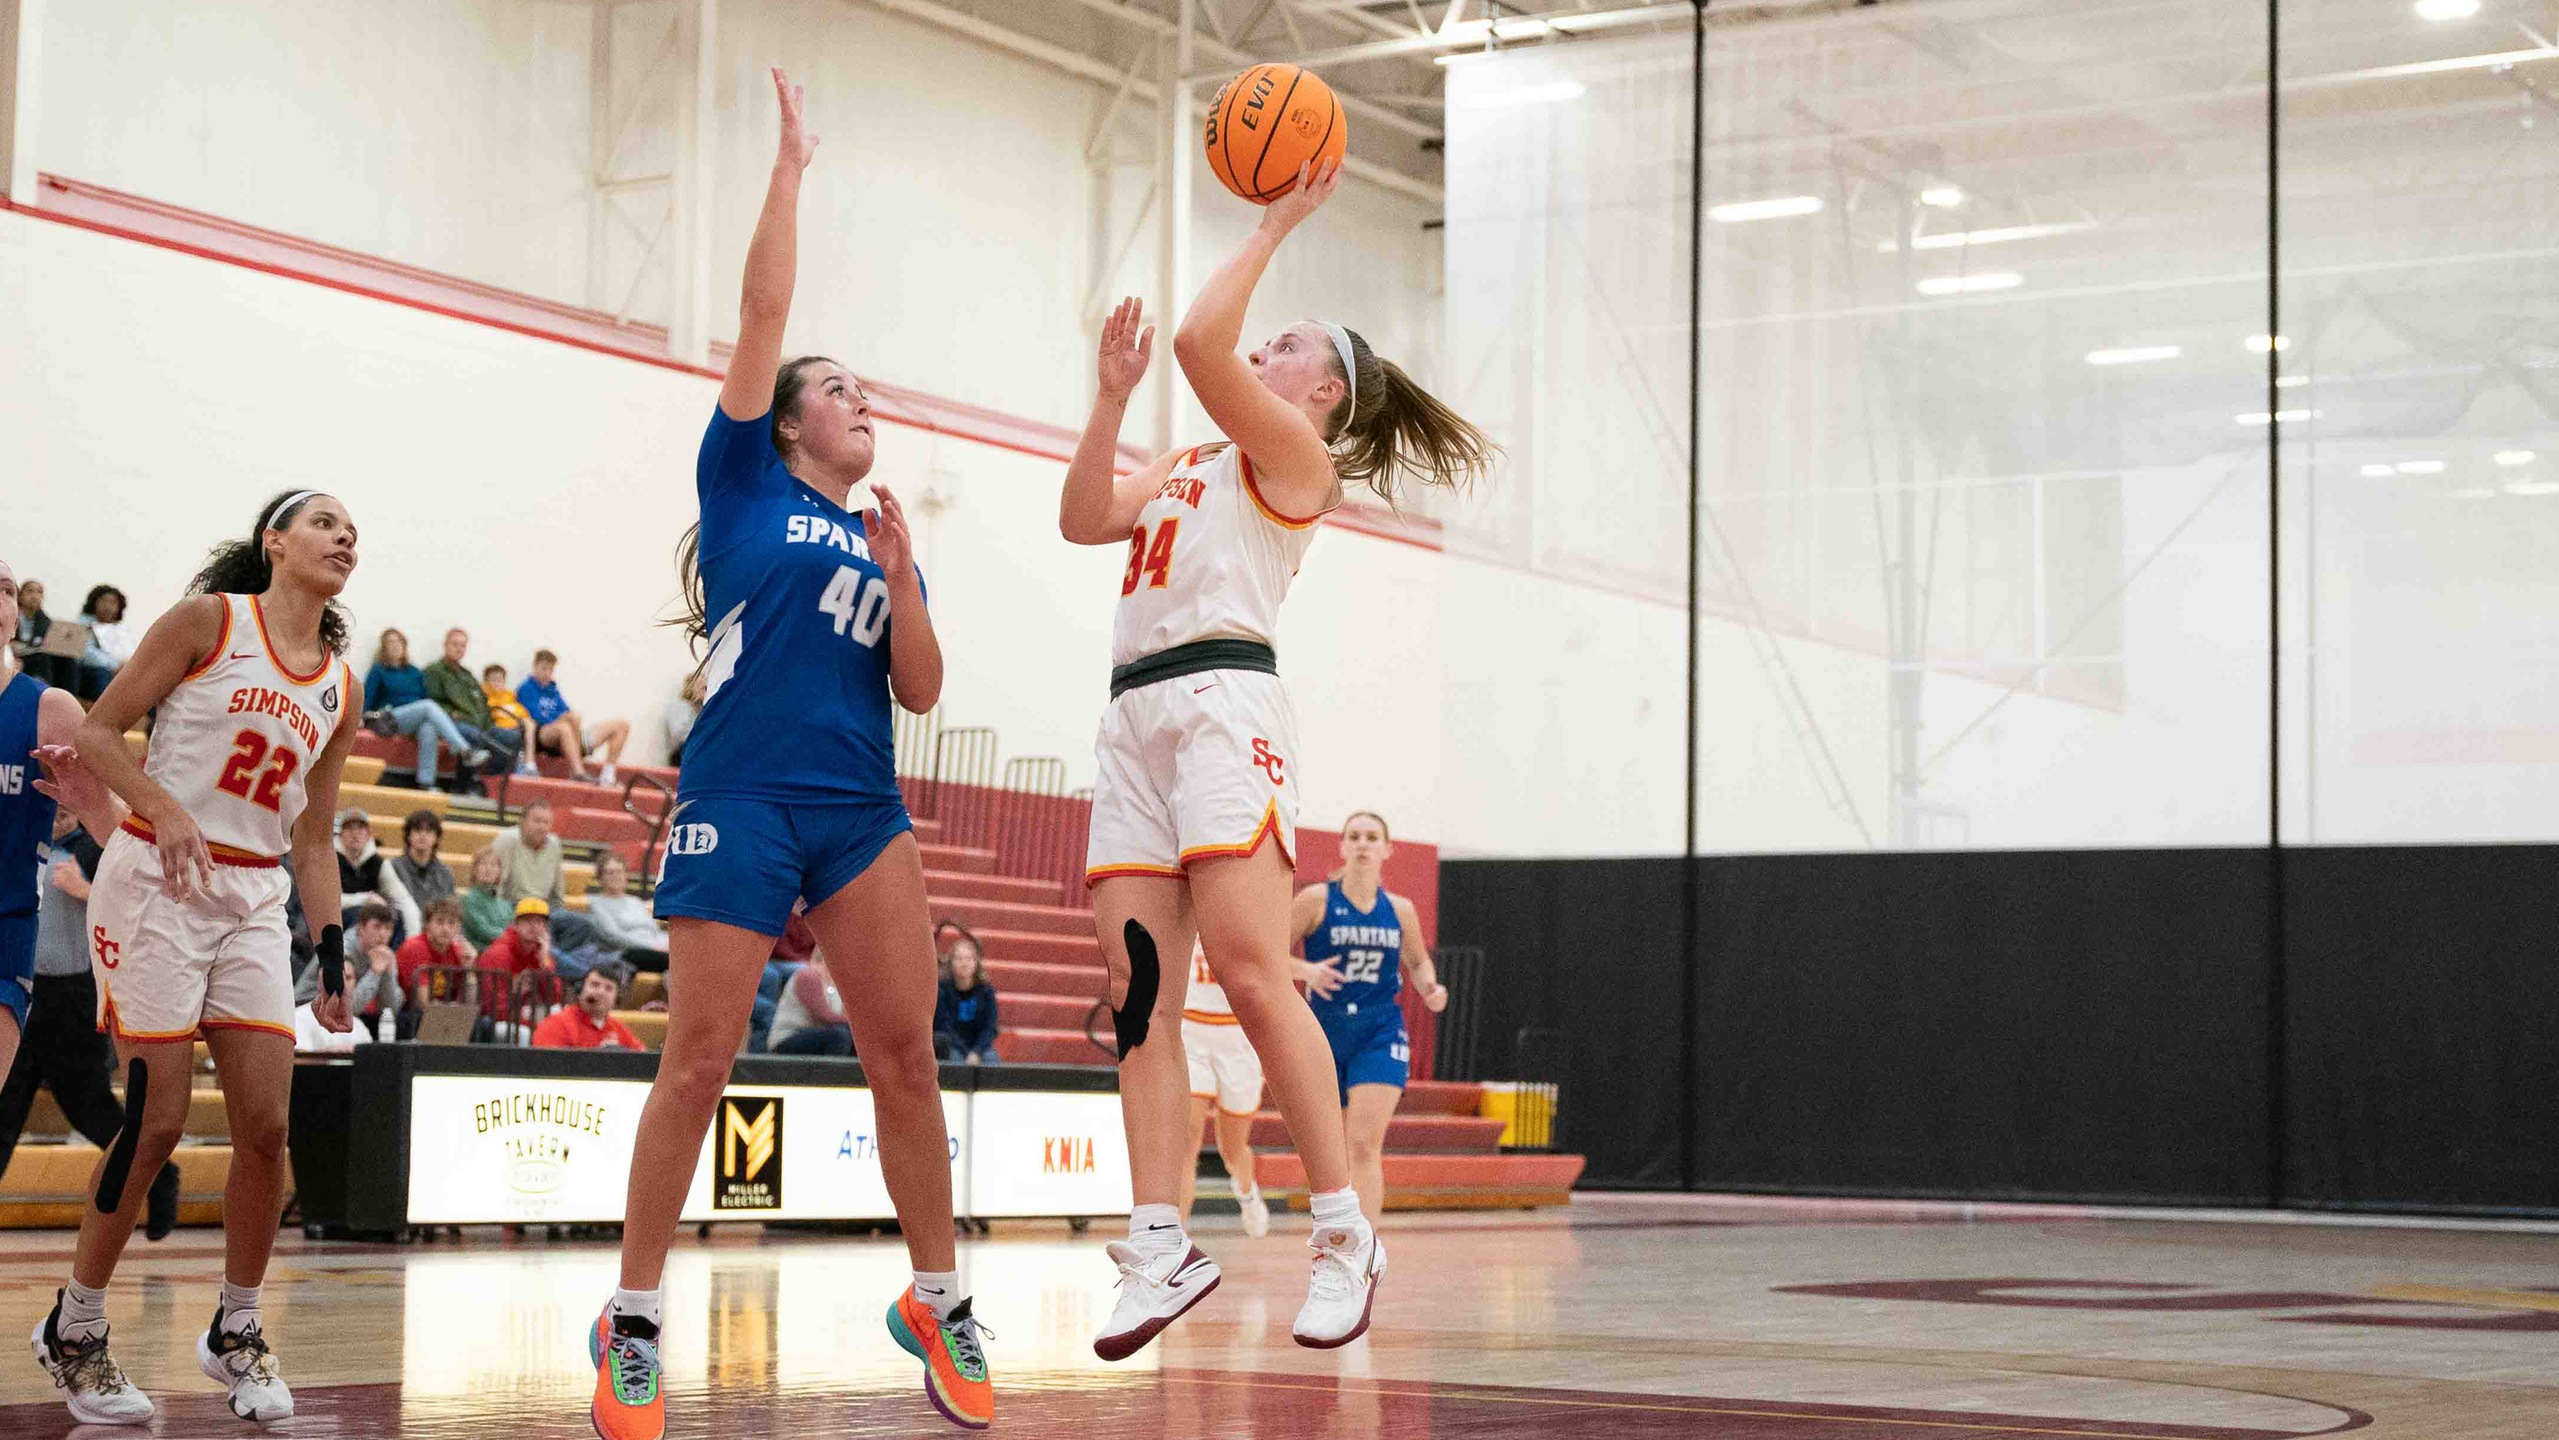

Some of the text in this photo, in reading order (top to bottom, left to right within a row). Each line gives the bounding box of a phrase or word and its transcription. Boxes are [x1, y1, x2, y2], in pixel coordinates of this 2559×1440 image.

[786, 514, 878, 565] SPAR
[1121, 516, 1181, 598] 34
[818, 564, 891, 649] 40
[227, 687, 320, 755] SIMPSON
[215, 727, 299, 814] 22
[1252, 737, 1285, 785] SC
[1345, 950, 1384, 984] 22
[475, 1093, 606, 1135] BRICKHOUSE
[721, 1194, 775, 1207] ELECTRIC
[728, 1183, 769, 1195] MILLER
